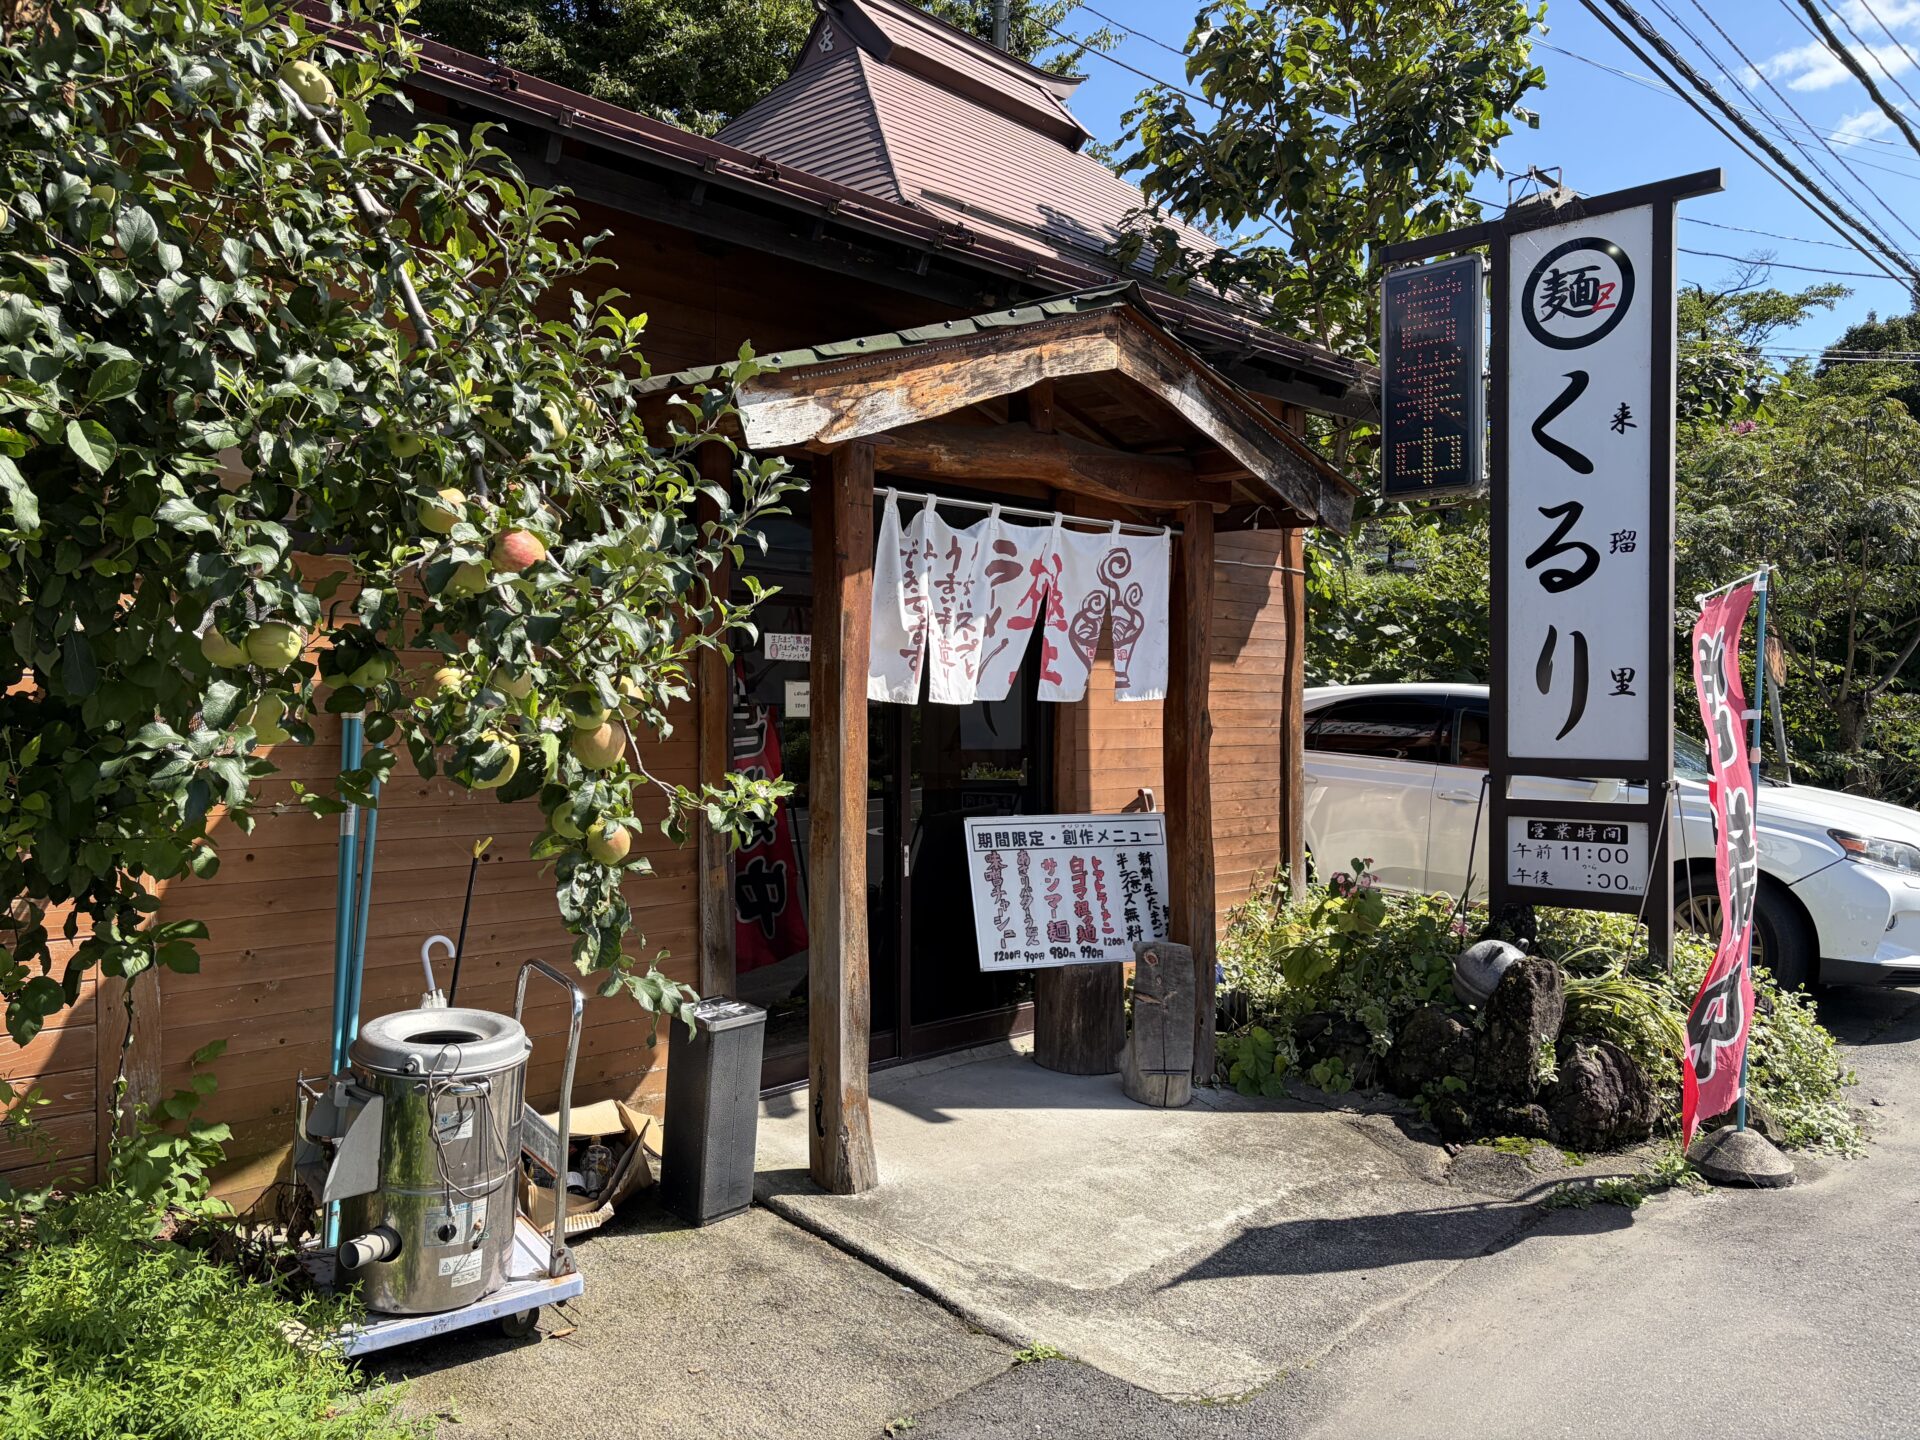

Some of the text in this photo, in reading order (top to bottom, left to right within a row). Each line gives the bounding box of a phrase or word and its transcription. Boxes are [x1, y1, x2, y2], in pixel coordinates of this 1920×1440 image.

[1395, 269, 1463, 485] 営業中
[1526, 370, 1600, 741] くるり
[1608, 402, 1638, 697] 来瑠里
[977, 828, 1159, 848] 期間限定・創作メニュー
[1512, 842, 1629, 864] 午前 11:00
[1530, 822, 1622, 842] 営業時間
[1041, 857, 1070, 943] サンマー麺
[1512, 867, 1553, 886] 午後
